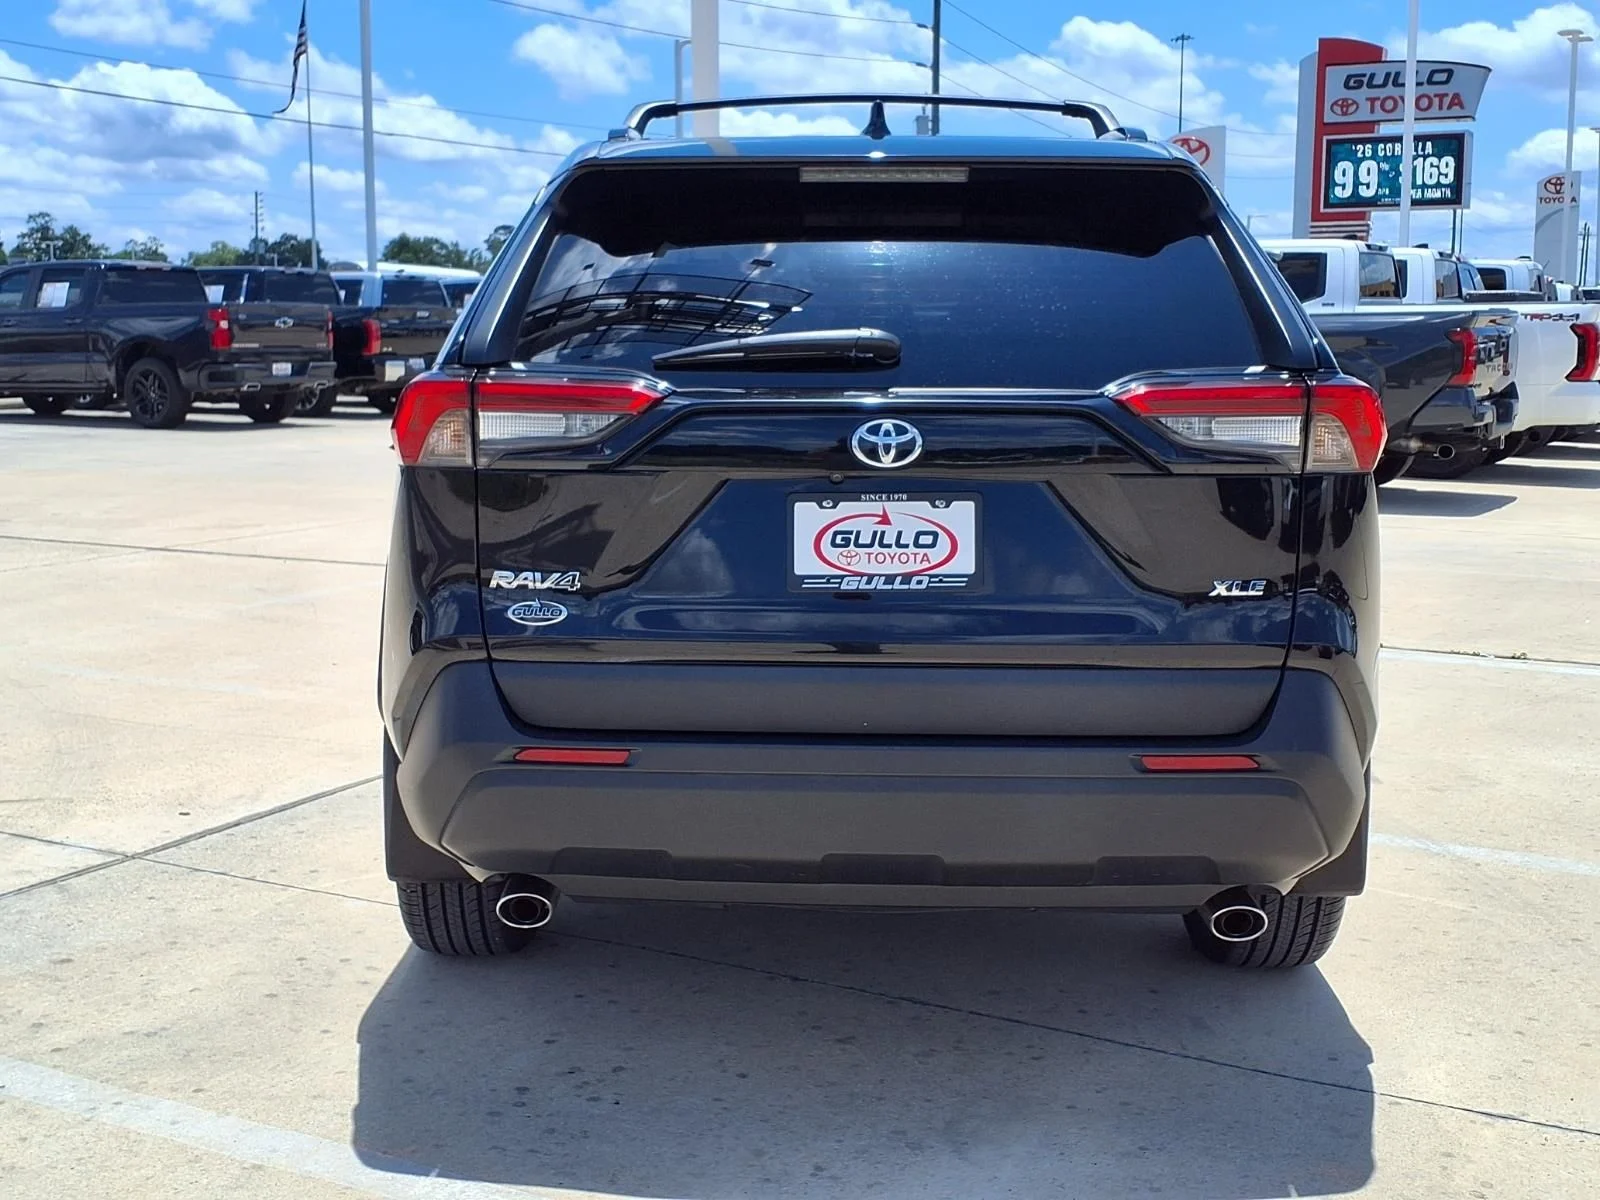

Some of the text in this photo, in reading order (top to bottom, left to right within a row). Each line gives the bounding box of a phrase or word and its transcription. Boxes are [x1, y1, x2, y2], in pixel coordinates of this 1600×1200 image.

[1378, 140, 1433, 156] CORLLA
[1538, 196, 1577, 204] TOYOA
[860, 493, 908, 501] SINCE 1970
[830, 530, 939, 549] GULLO
[864, 552, 931, 565] TOYOTA
[489, 570, 581, 591] RAV4
[840, 576, 930, 590] GULLO
[1208, 580, 1267, 596] XLE
[511, 606, 564, 618] GULLO
